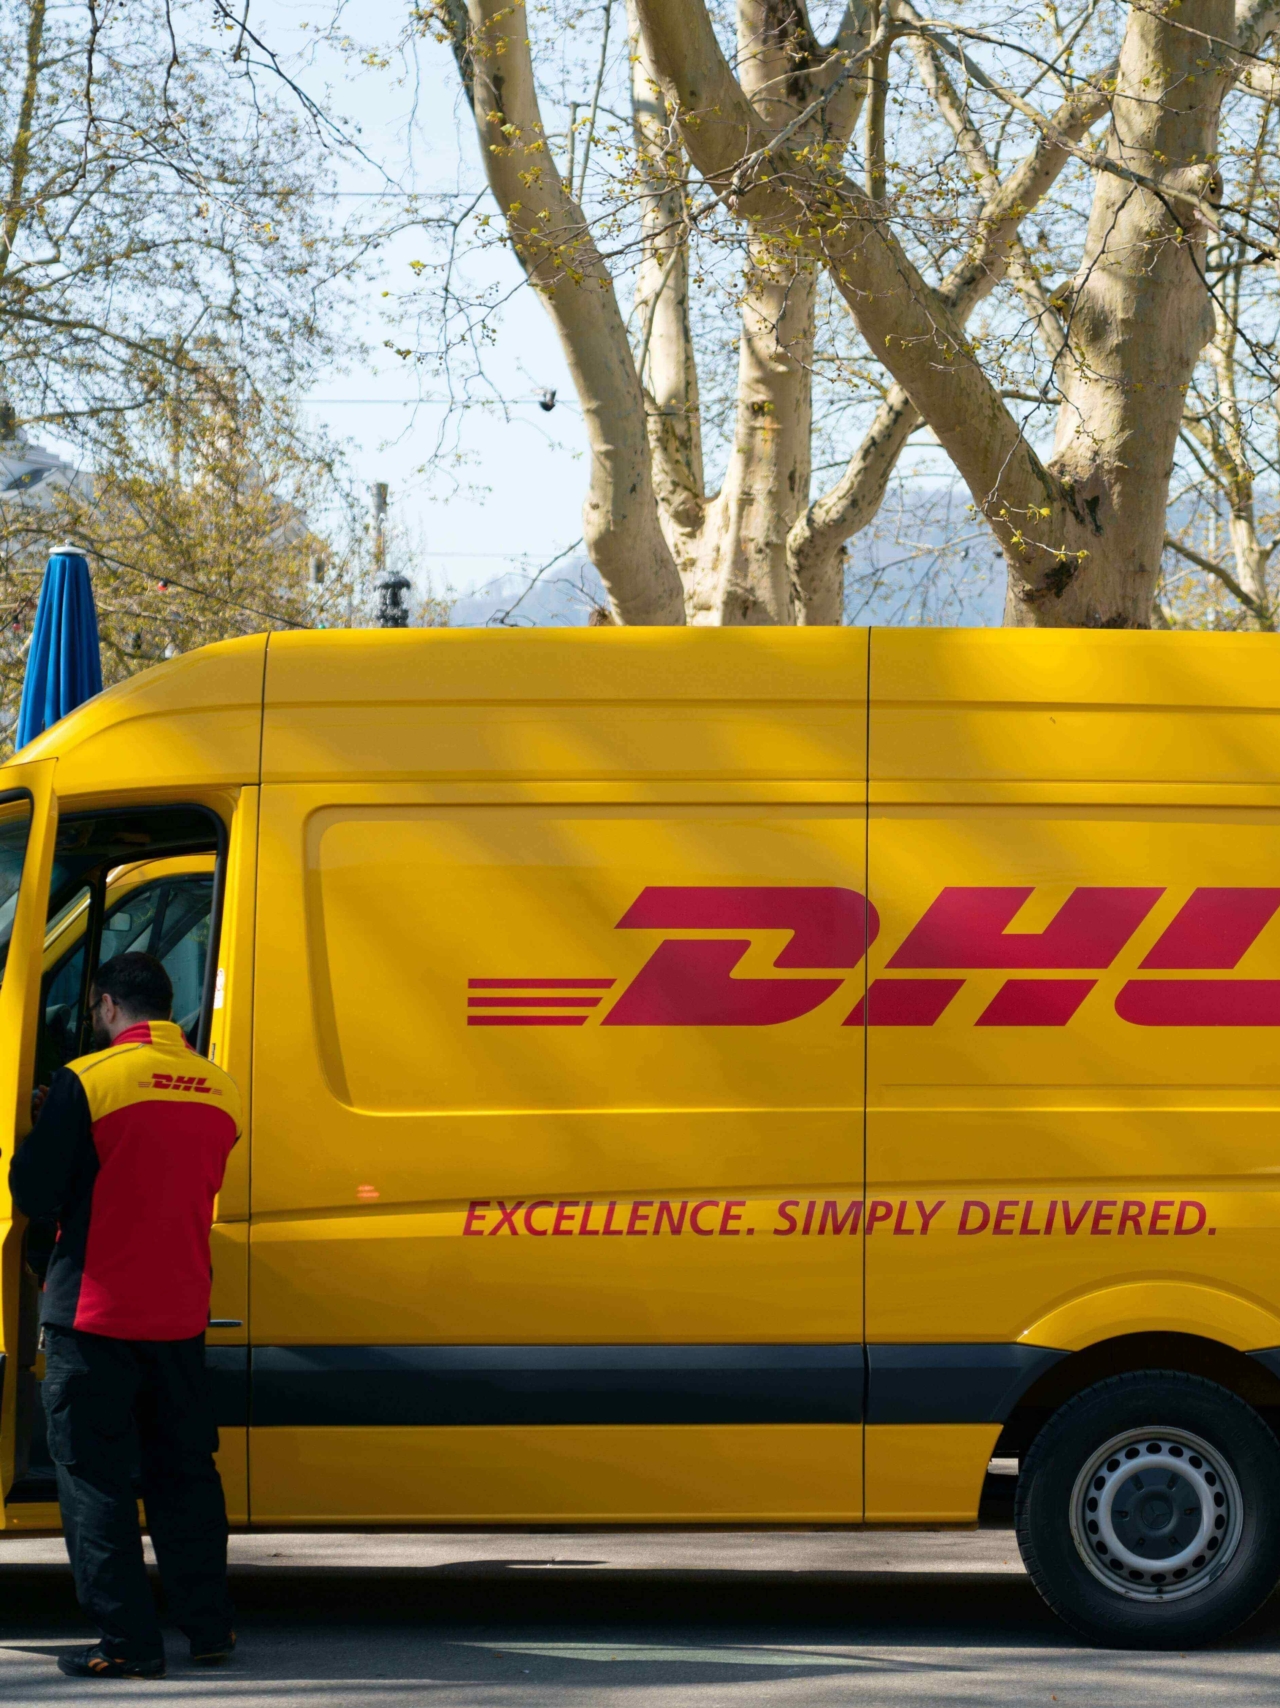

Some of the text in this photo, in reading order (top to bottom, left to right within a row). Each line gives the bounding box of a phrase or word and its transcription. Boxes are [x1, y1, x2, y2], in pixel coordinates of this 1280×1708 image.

[151, 1073, 212, 1094] DHL
[461, 1200, 1218, 1236] EXCELLENCE. SIMPLY DELIVERED.
